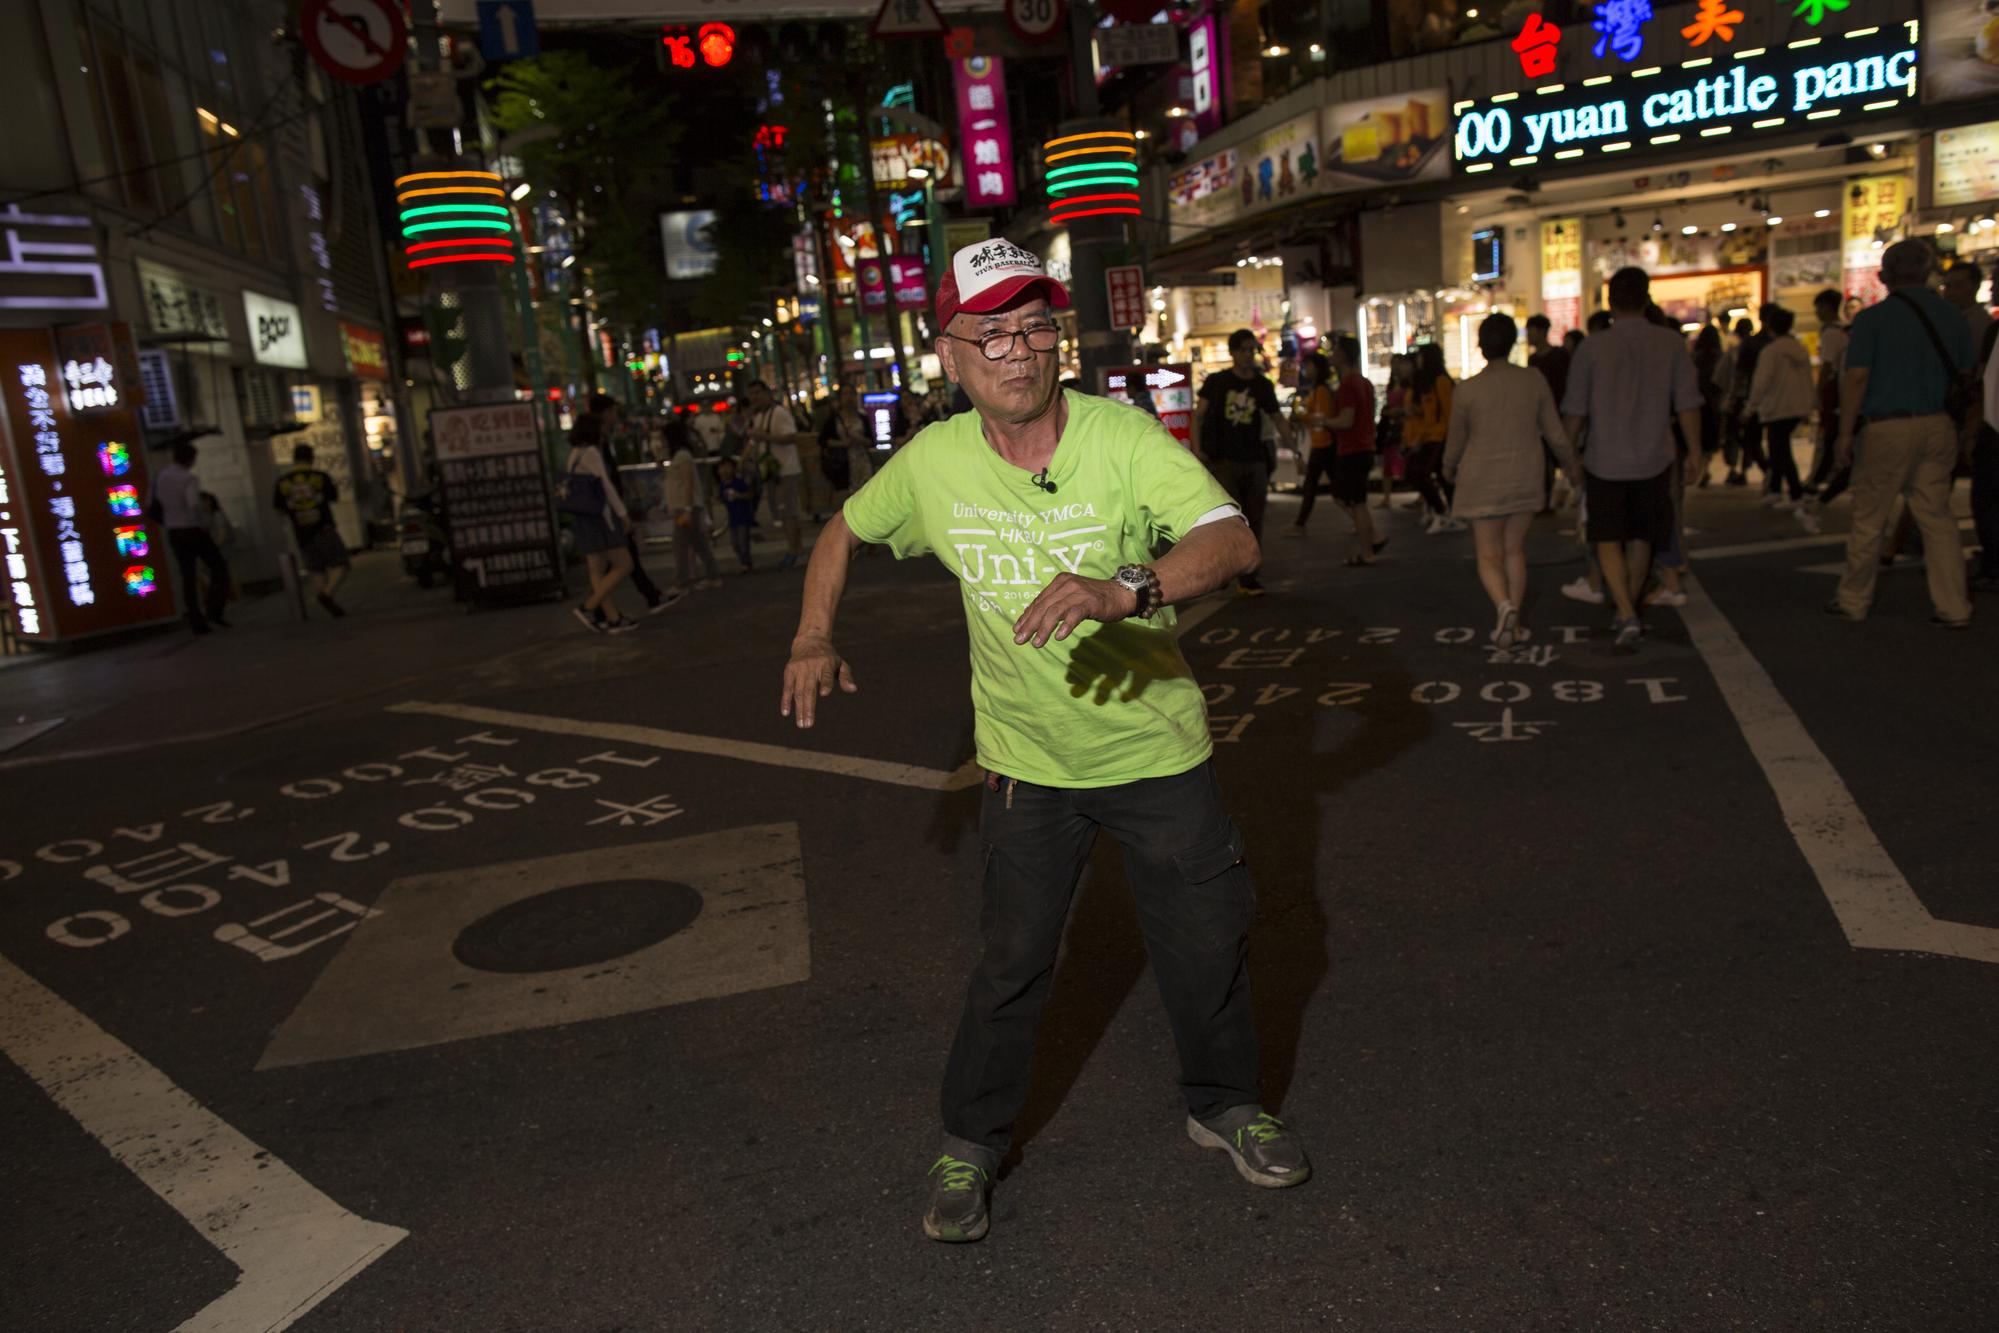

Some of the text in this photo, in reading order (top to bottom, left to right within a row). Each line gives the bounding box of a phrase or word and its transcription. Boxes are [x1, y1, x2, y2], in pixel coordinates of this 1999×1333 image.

[1019, 0, 1050, 22] 30
[1523, 98, 1628, 153] yuan
[1642, 65, 1779, 129] cattle
[975, 264, 993, 277] VIVA
[953, 503, 1096, 528] University YMCA
[1000, 528, 1045, 545] HKBU
[954, 542, 1093, 585] Uni-Y
[1205, 678, 1688, 706] 1800 240
[46, 750, 661, 948] 1800 2400
[213, 891, 384, 963] 日
